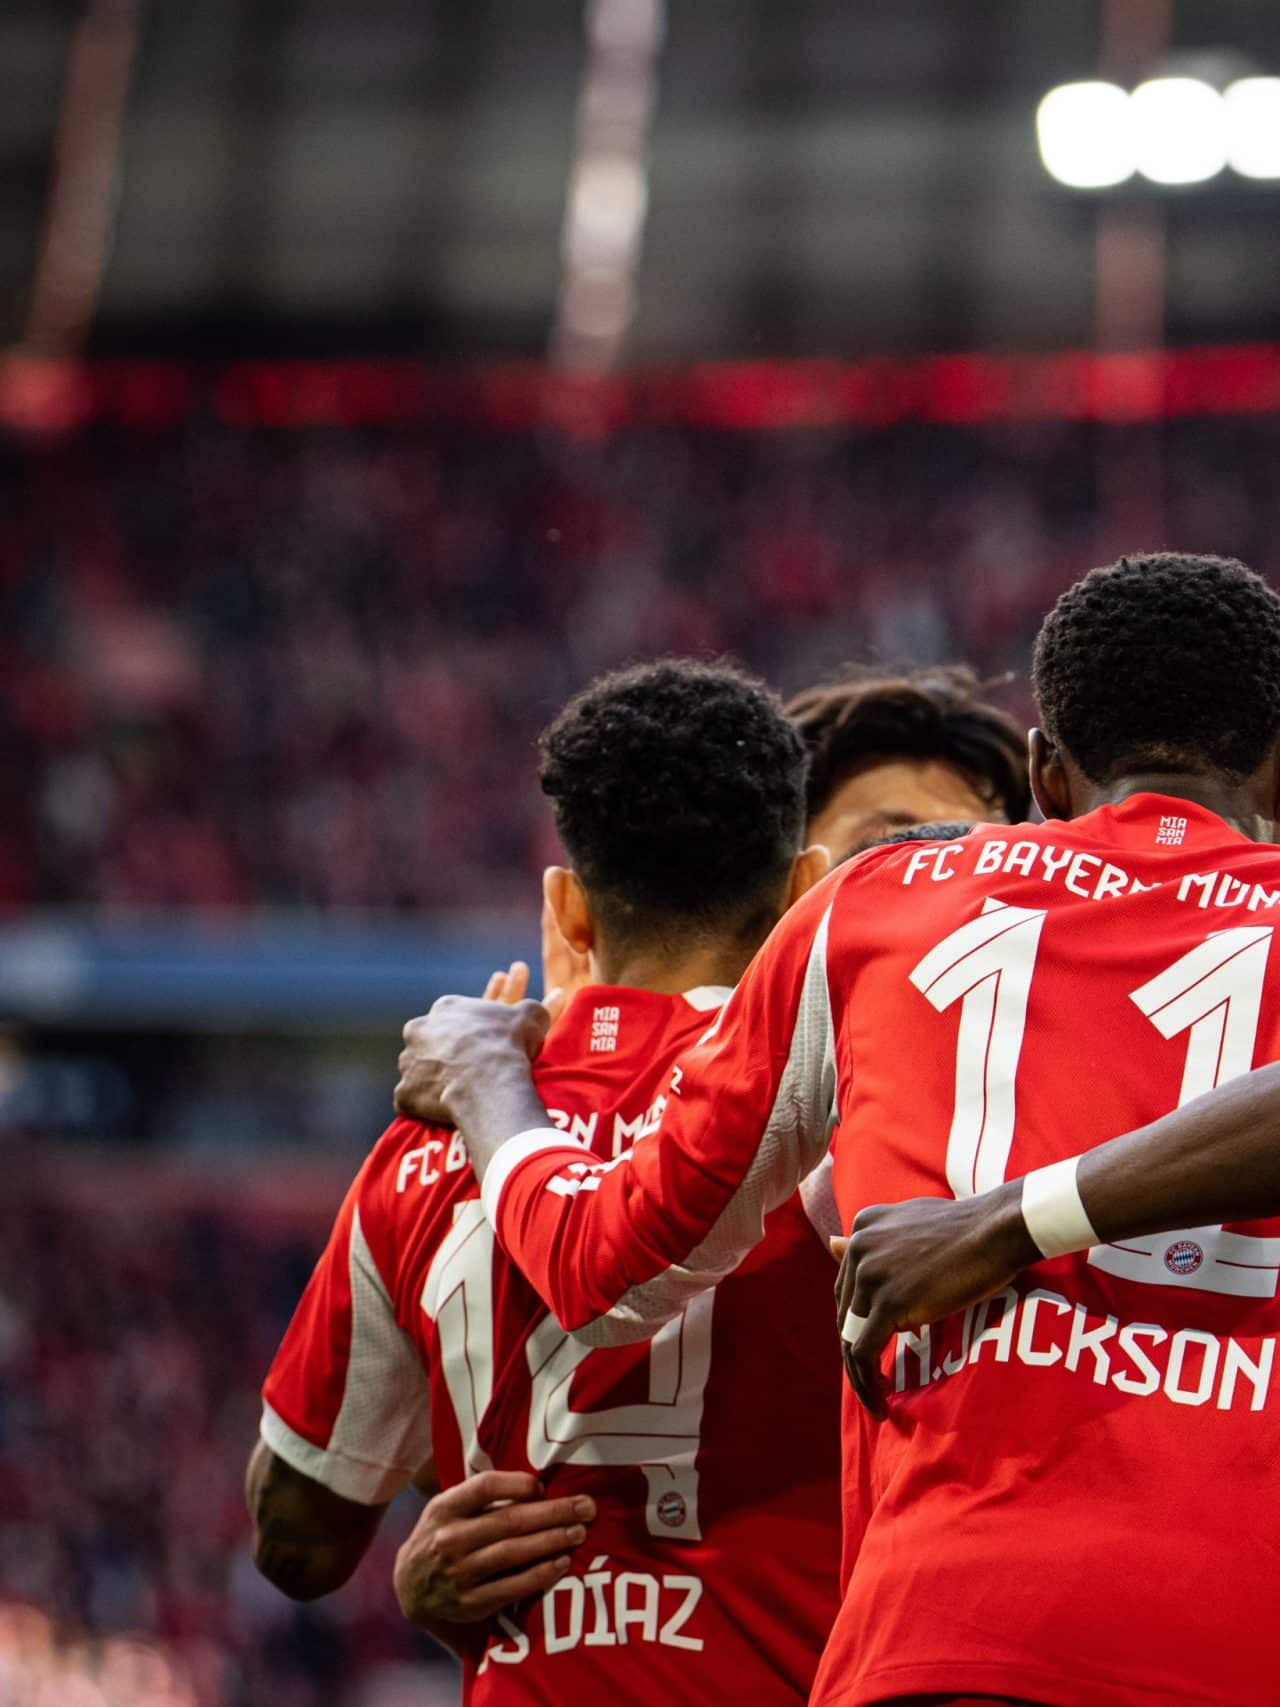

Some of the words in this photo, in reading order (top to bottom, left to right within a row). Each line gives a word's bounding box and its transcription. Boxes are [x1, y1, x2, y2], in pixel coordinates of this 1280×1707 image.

[1160, 815, 1187, 828] MIA
[1158, 827, 1185, 838] SAN
[1155, 836, 1183, 845] MIA
[902, 844, 964, 886] FC
[593, 1006, 620, 1021] MIA
[592, 1022, 618, 1036] SAN
[590, 1036, 616, 1052] MIA
[396, 1140, 443, 1193] FC
[543, 1555, 704, 1655] DÍAZ
